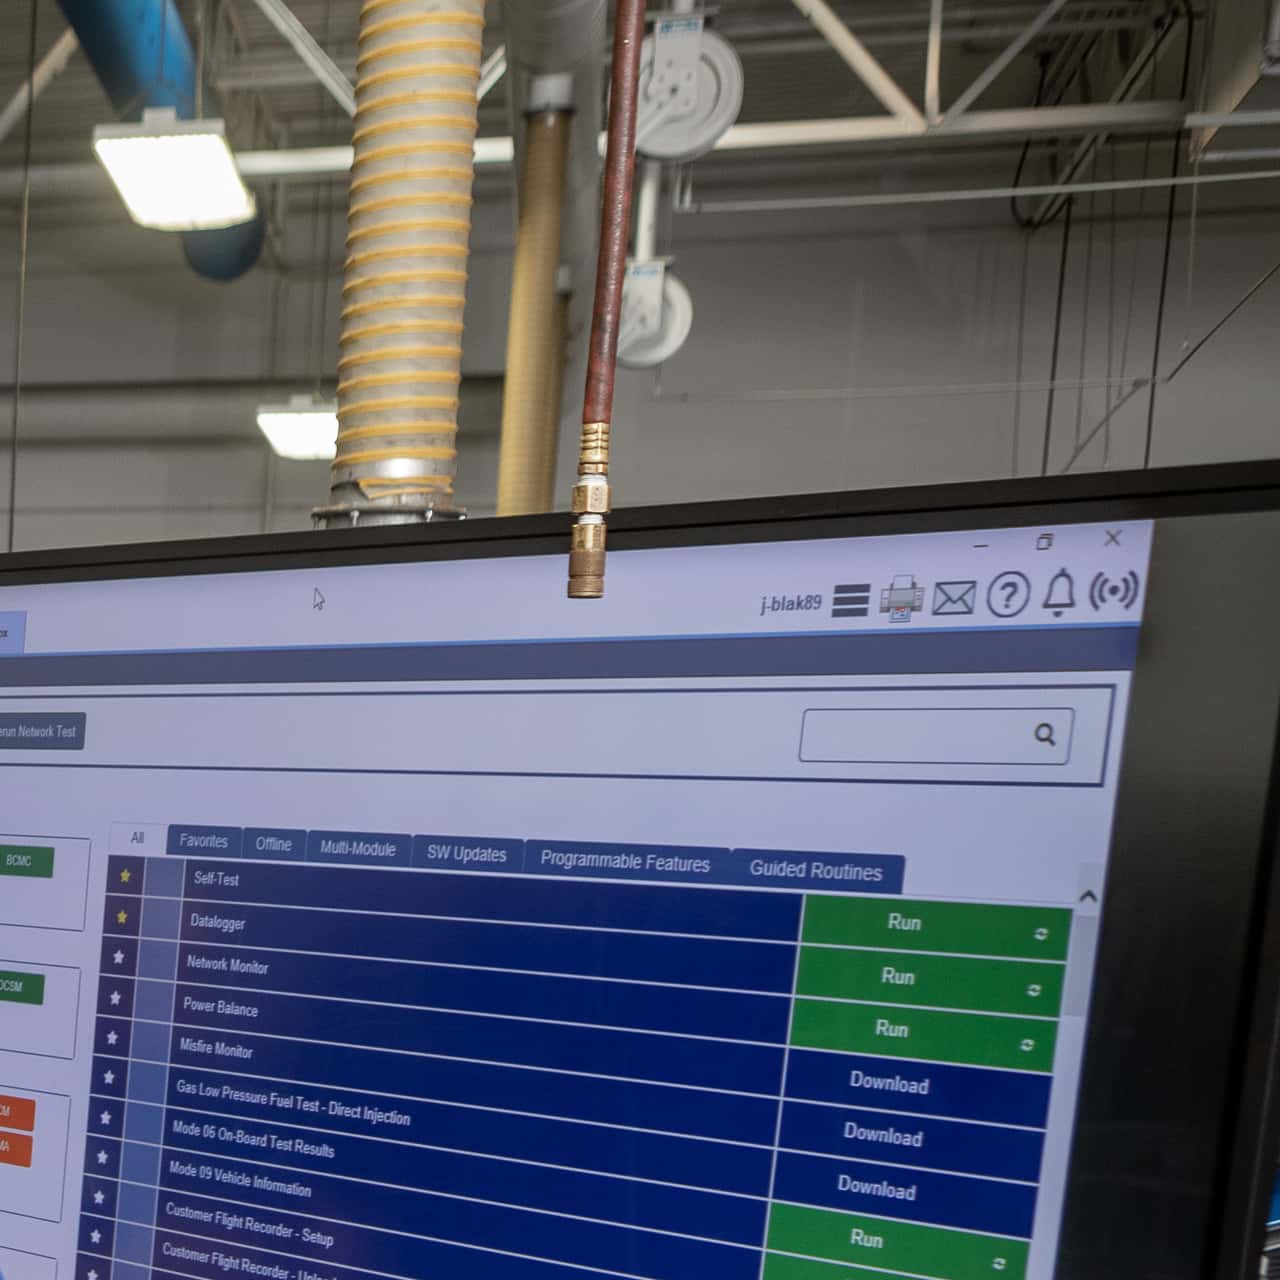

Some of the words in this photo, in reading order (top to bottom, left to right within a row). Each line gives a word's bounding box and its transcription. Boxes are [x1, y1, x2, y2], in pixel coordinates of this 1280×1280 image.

[17, 723, 54, 737] Network
[55, 723, 76, 738] Test
[129, 830, 145, 844] All
[178, 832, 229, 848] Favorites
[254, 835, 293, 852] Offline
[319, 838, 396, 857] Multi-Module
[426, 843, 451, 860] SW
[452, 845, 507, 864] Updates
[540, 848, 642, 870] Programmable
[644, 853, 711, 873] Features
[192, 869, 240, 887] Self-Test
[748, 858, 807, 877] Guided
[809, 861, 883, 881] Routines
[188, 911, 246, 933] Datalogger
[886, 911, 922, 931] Run
[185, 953, 229, 971] Network
[228, 957, 270, 975] Monitor
[880, 965, 916, 985] Run
[182, 994, 216, 1013] Power
[215, 998, 259, 1018] Balance
[874, 1017, 909, 1038] Run
[178, 1035, 214, 1054] Misfire
[213, 1040, 254, 1059] Monitor
[849, 1069, 930, 1095] Download
[175, 1078, 198, 1095] Gas
[197, 1081, 221, 1097] Low
[220, 1084, 268, 1105] Pressure
[268, 1091, 294, 1109] Fuel
[294, 1094, 320, 1113] Test
[327, 1099, 362, 1119] Direct
[362, 1105, 411, 1126] Injection
[171, 1118, 201, 1137] Mode
[201, 1123, 216, 1139] 06
[216, 1126, 268, 1148] On-Board
[268, 1134, 293, 1152] Test
[293, 1137, 335, 1159] Results
[842, 1120, 924, 1147] Download
[168, 1159, 198, 1177] Mode
[197, 1164, 213, 1180] 09
[213, 1166, 252, 1187] Vehicle
[251, 1174, 312, 1198] Information
[836, 1173, 917, 1201] Download
[164, 1200, 214, 1222] Customer
[213, 1209, 244, 1231] Flight
[243, 1215, 294, 1238] Recorder
[300, 1226, 334, 1250] Setup
[849, 1227, 884, 1249] Run
[161, 1240, 211, 1264] Customer
[210, 1250, 240, 1272] Flight
[239, 1257, 290, 1280] Recorder
